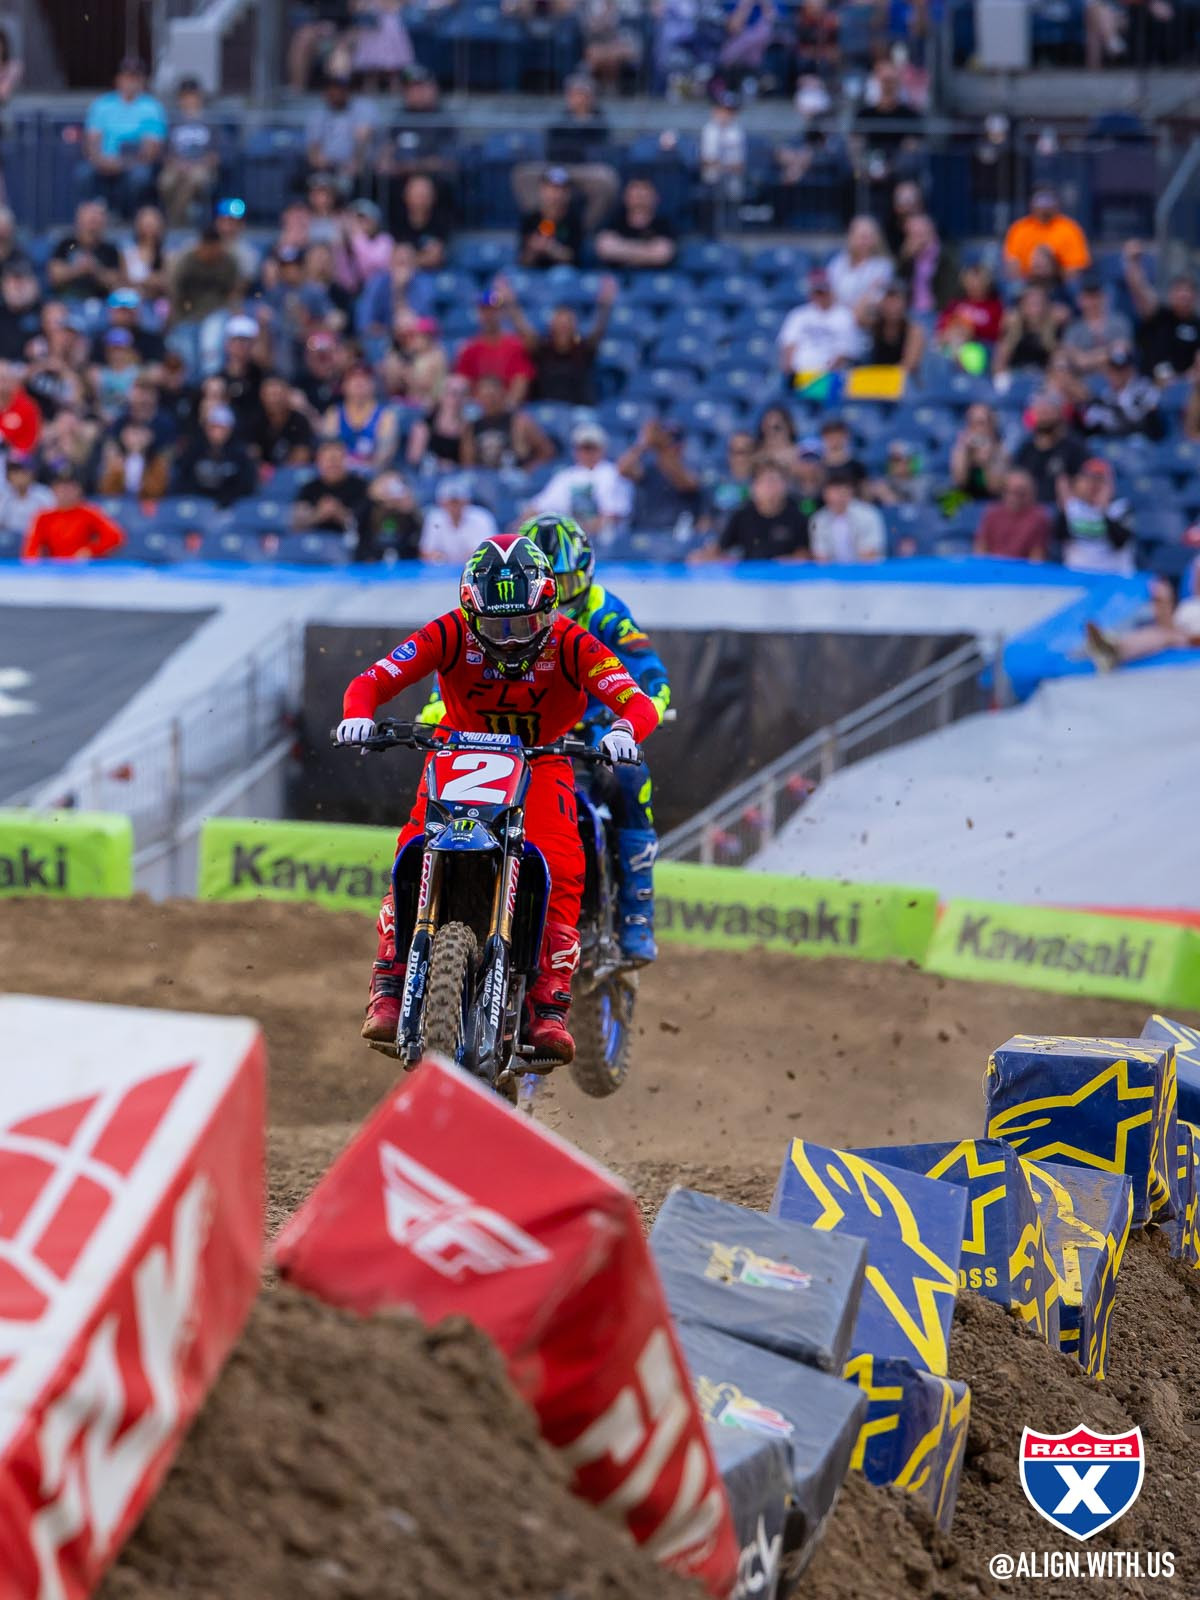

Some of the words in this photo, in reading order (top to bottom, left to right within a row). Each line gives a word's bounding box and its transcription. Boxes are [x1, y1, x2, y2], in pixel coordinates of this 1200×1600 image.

[467, 683, 549, 708] FLY
[461, 731, 509, 744] PROTAPER
[440, 753, 515, 804] 2
[230, 843, 396, 898] Kawas
[656, 898, 861, 947] awasaki
[956, 910, 1154, 982] Kawasaki
[490, 958, 505, 1029] DUNLOP
